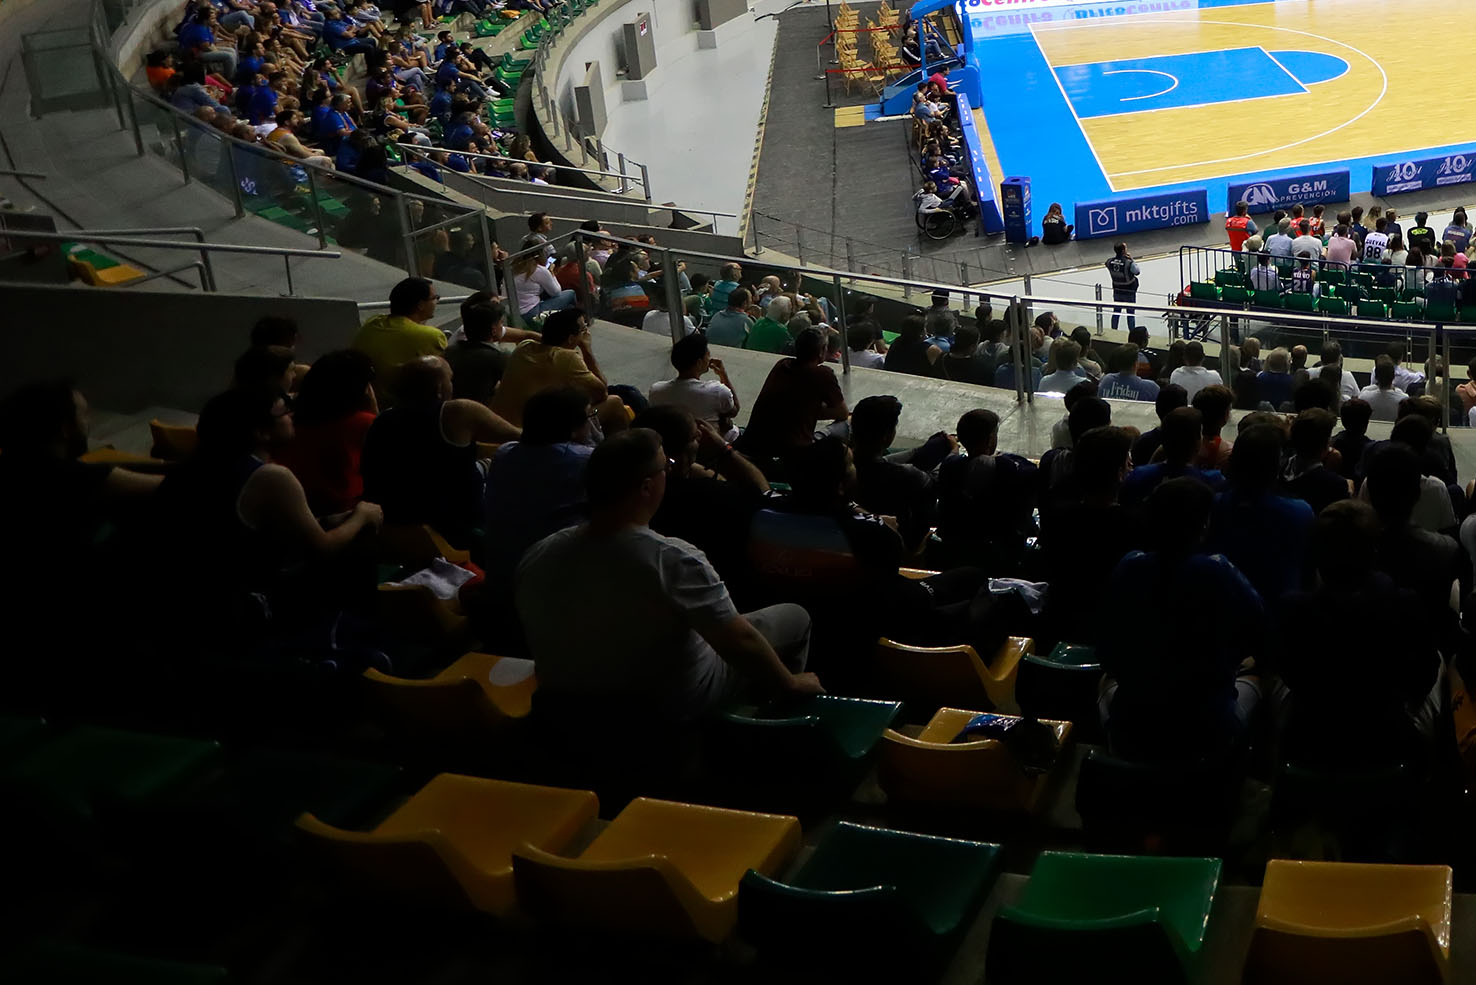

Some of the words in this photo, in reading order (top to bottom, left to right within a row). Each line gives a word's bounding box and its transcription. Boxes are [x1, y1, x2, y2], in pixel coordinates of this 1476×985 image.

[1288, 180, 1327, 194] G&M
[1126, 200, 1198, 222] mktgifts
[1170, 214, 1198, 226] .com
[1366, 246, 1382, 259] 88
